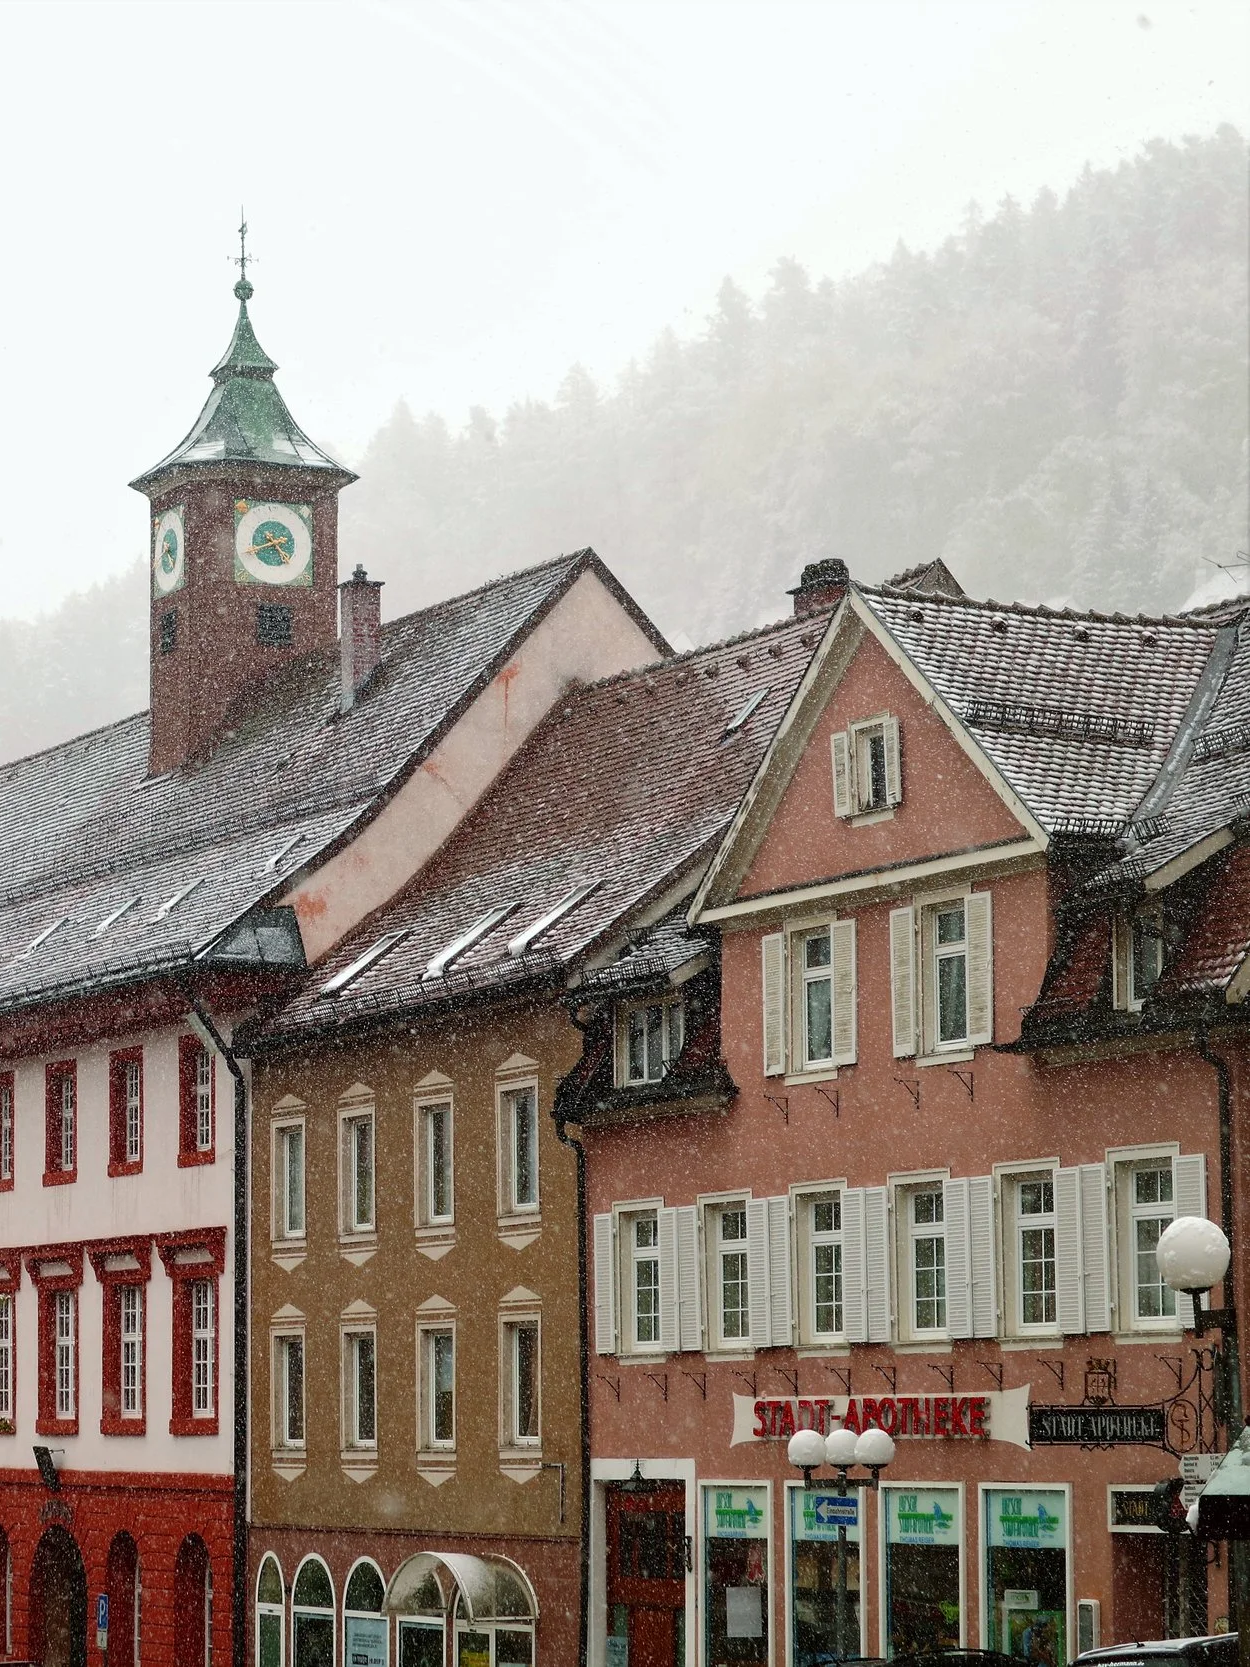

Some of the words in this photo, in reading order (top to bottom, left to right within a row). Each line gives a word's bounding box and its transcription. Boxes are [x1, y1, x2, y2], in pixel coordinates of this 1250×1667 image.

[753, 1397, 990, 1439] STADT-APOTHEKE
[1042, 1415, 1083, 1437] STADT
[99, 1599, 106, 1625] P
